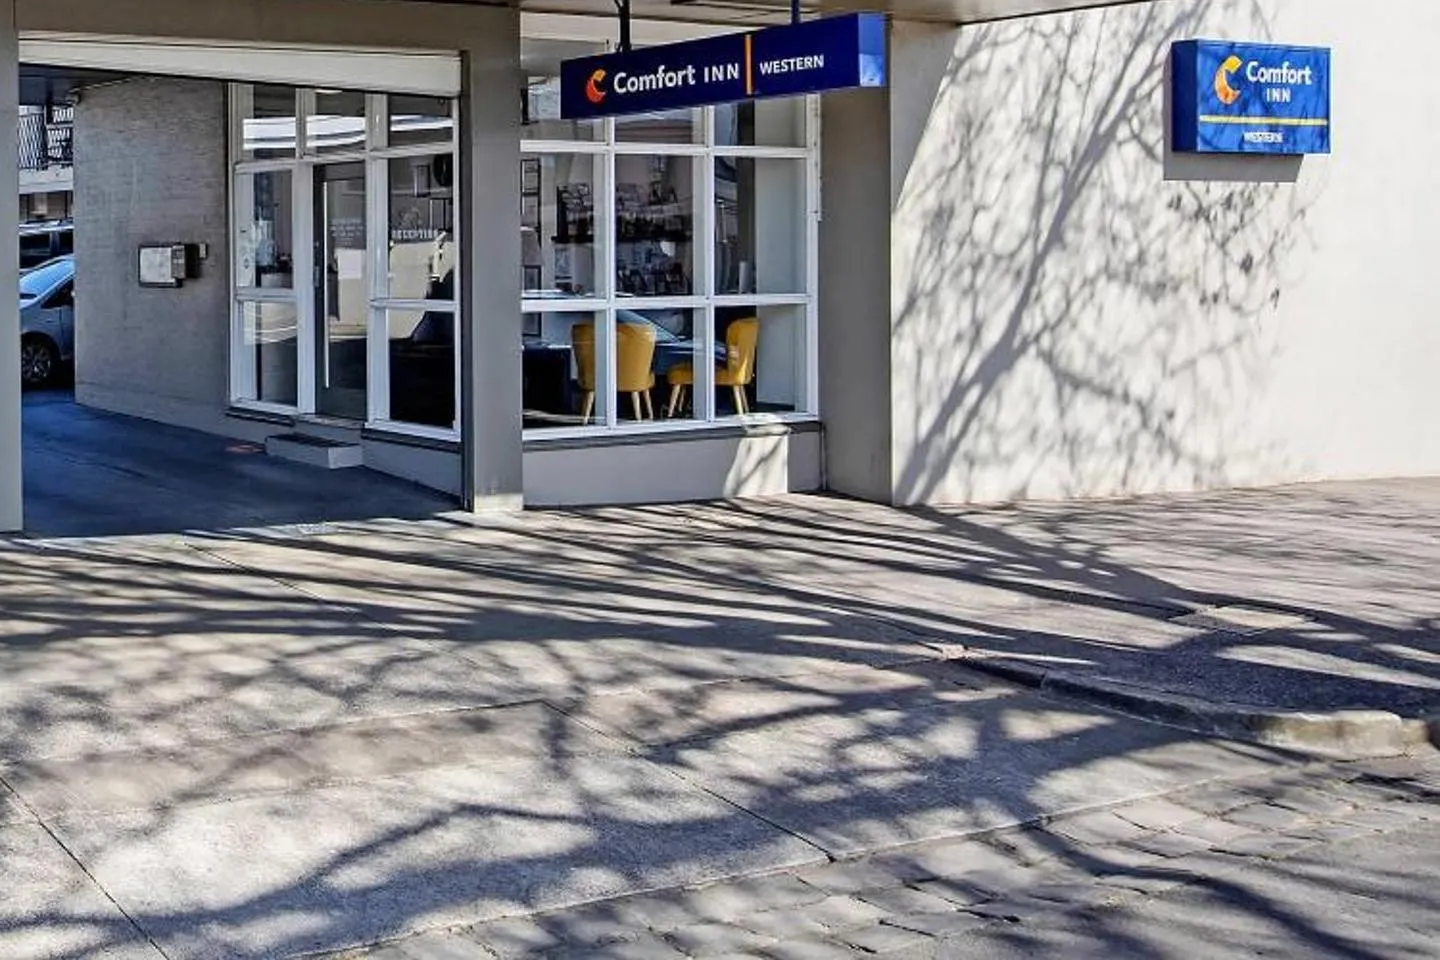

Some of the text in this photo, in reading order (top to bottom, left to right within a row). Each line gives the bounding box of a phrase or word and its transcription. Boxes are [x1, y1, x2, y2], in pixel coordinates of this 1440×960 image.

[613, 54, 825, 94] Comfort INN WESTERN
[1245, 60, 1312, 86] Comfort
[1265, 87, 1291, 103] INN
